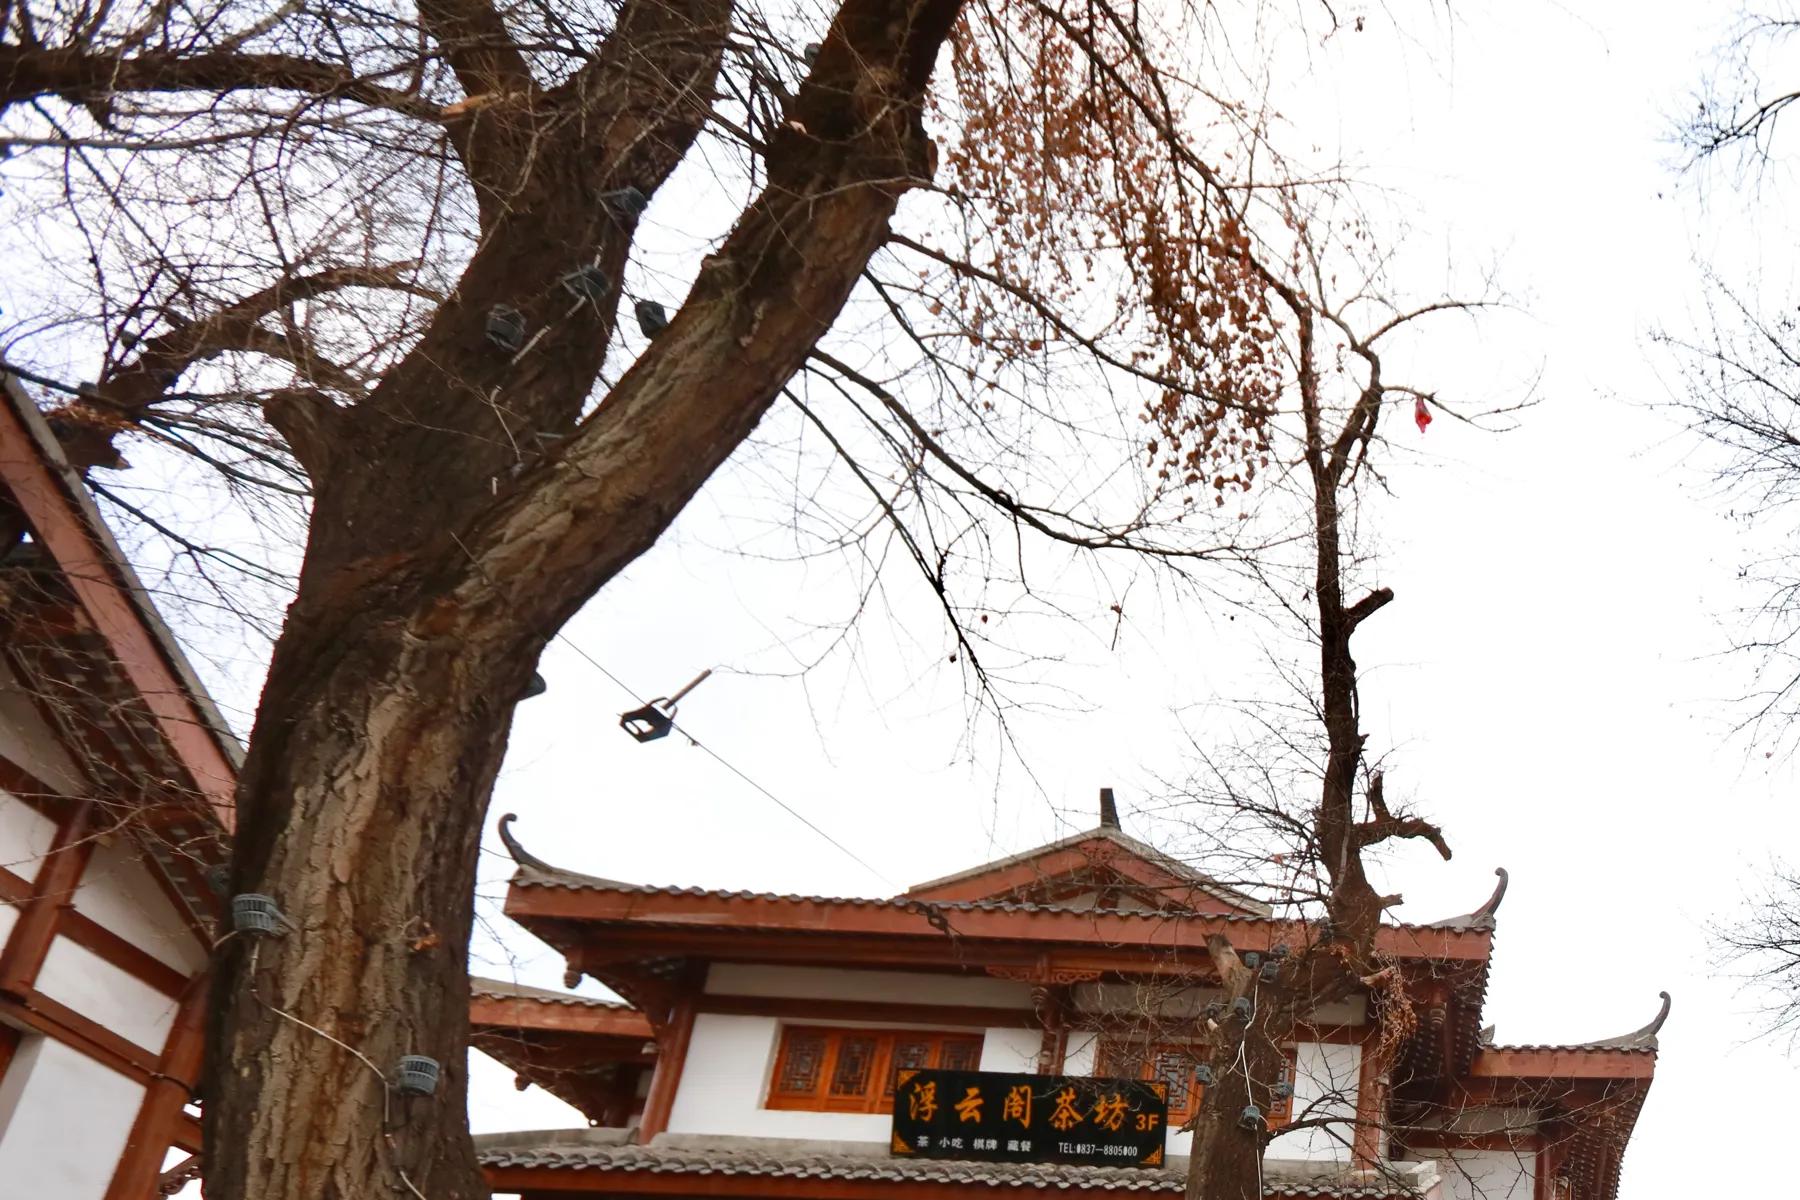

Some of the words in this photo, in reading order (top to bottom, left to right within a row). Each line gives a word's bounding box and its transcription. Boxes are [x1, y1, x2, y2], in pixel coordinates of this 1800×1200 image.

[909, 1081, 1129, 1131] 浮云阁茶坊
[1136, 1114, 1159, 1131] 3F
[917, 1136, 929, 1148] 茶
[939, 1137, 963, 1149] 小吃
[973, 1138, 998, 1150] 棋牌
[1007, 1140, 1032, 1152] 藏餐
